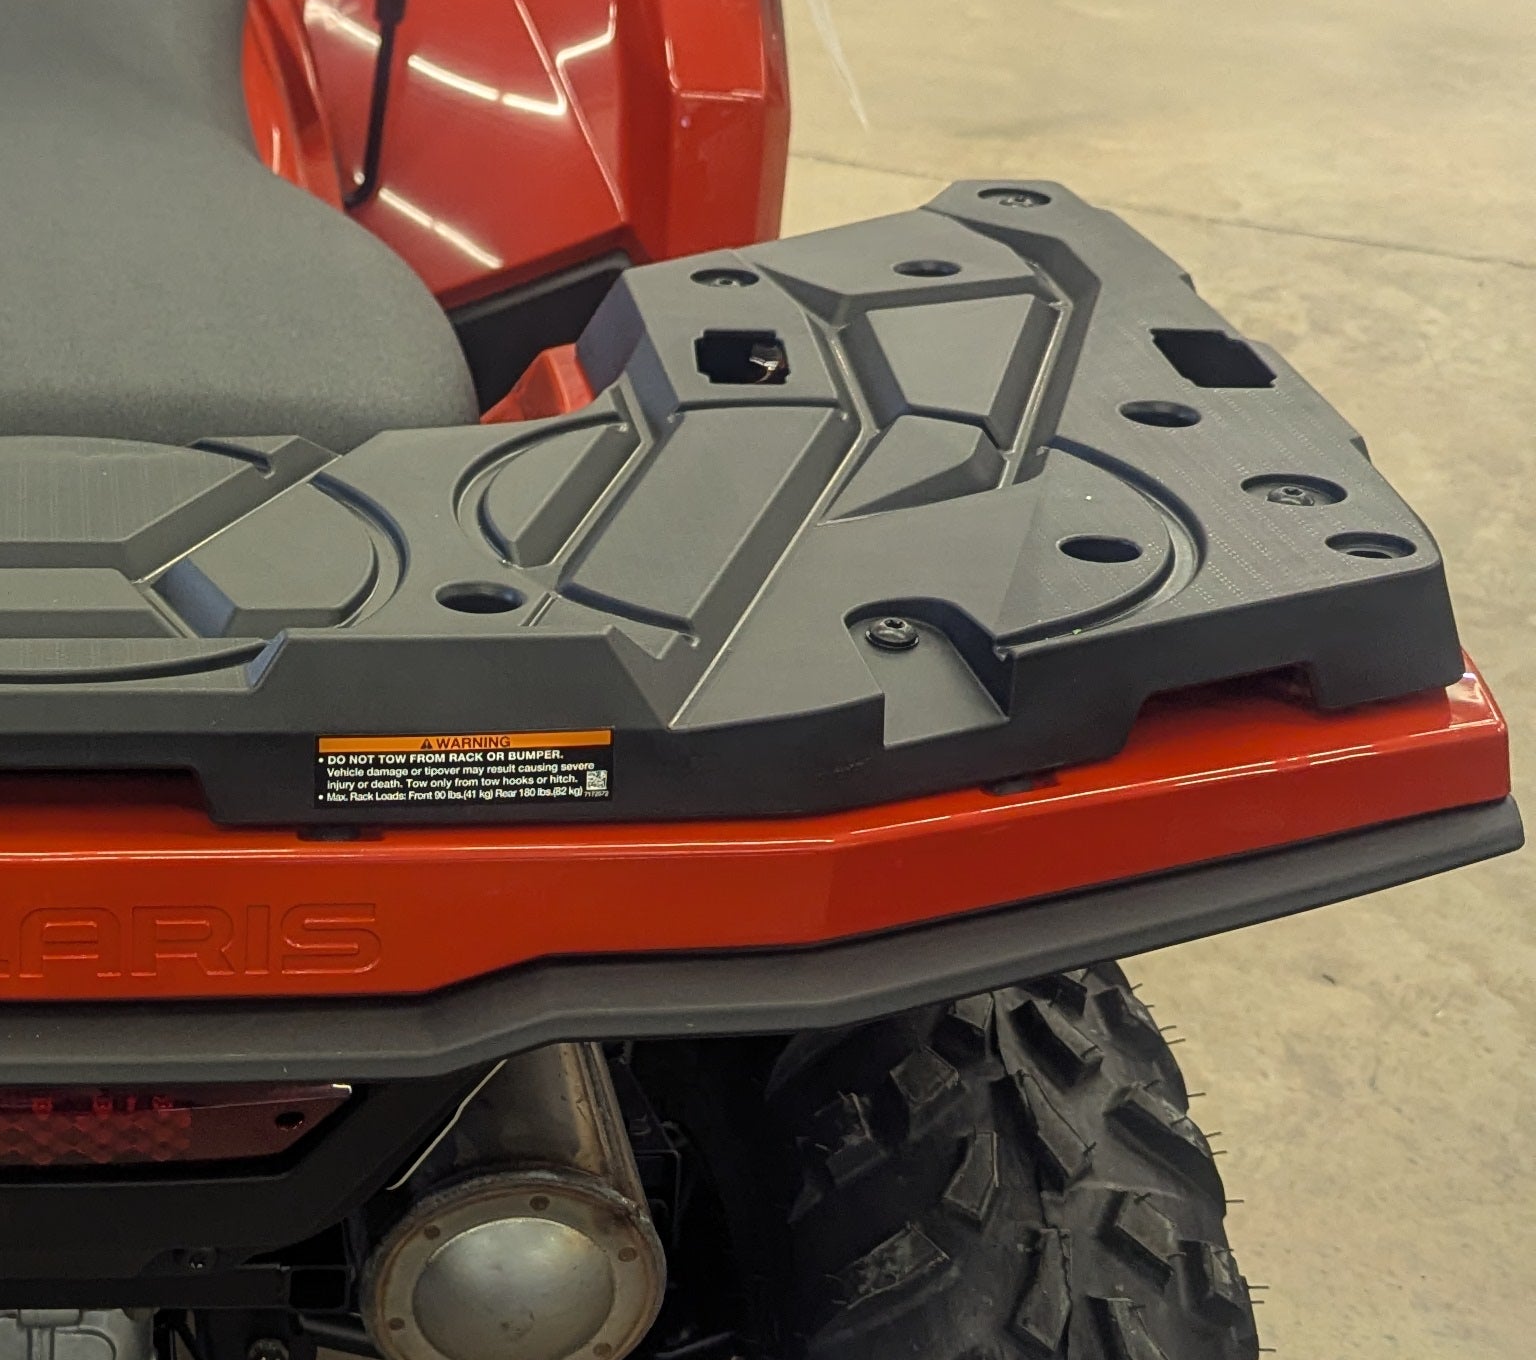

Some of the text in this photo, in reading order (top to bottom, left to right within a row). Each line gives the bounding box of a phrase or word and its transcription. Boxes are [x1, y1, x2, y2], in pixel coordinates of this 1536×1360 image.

[436, 736, 511, 749] WARNING
[327, 750, 564, 765] DO NOT TOW FROM RACK OR BUMPER.
[327, 762, 595, 778] Vehicle damage or tipover may result causing severe
[327, 774, 578, 791] injury or death. Tow only from tow hooks or hitch.
[327, 792, 348, 801] Max.
[350, 791, 373, 801] Rack
[375, 791, 406, 801] Loads:
[408, 790, 432, 800] Front
[434, 790, 446, 800] 90
[479, 789, 494, 800] kg)
[495, 789, 518, 798] Rear
[519, 788, 536, 797] 180
[568, 786, 583, 797] kg)
